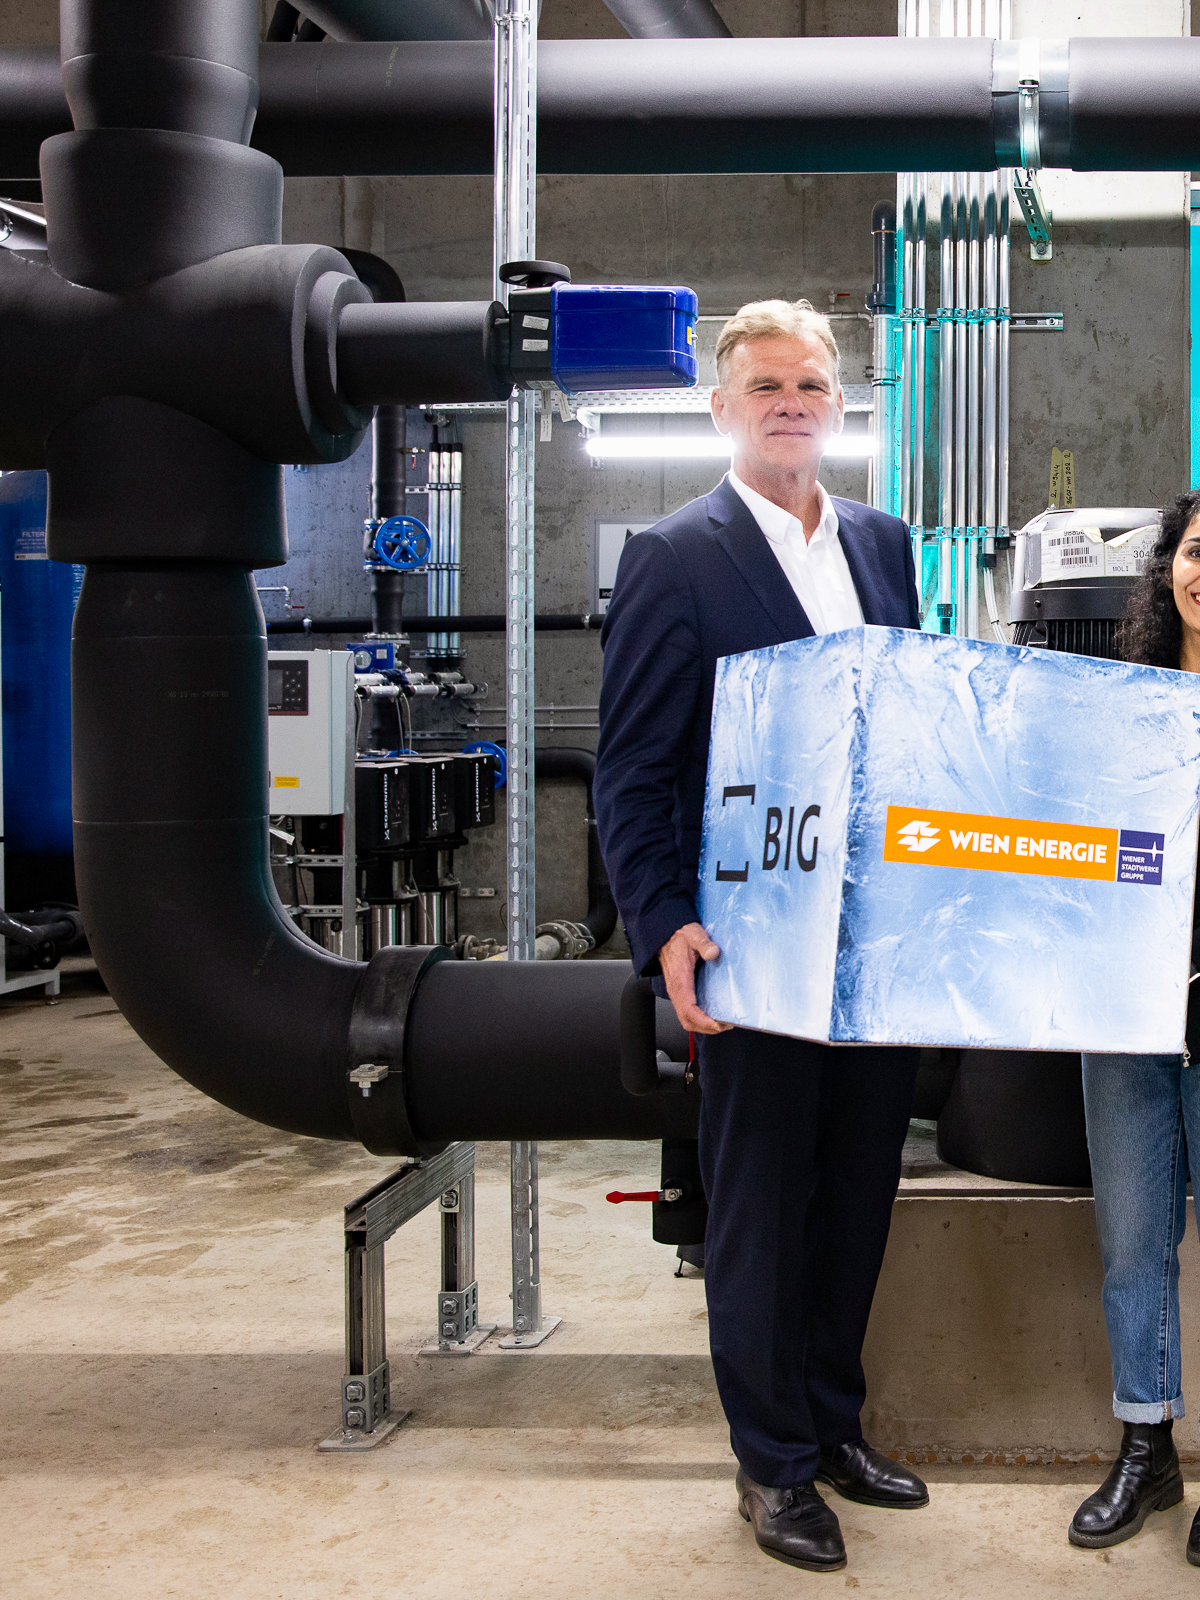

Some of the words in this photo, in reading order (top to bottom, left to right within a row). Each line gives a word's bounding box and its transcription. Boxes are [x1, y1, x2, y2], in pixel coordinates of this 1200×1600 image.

[761, 804, 821, 873] BIG
[949, 829, 1010, 855] WIEN
[1015, 836, 1108, 864] ENERGIE
[1121, 855, 1145, 864] WIENER
[1121, 863, 1160, 873] STADTWERKE
[1120, 871, 1144, 881] GRUPPE
